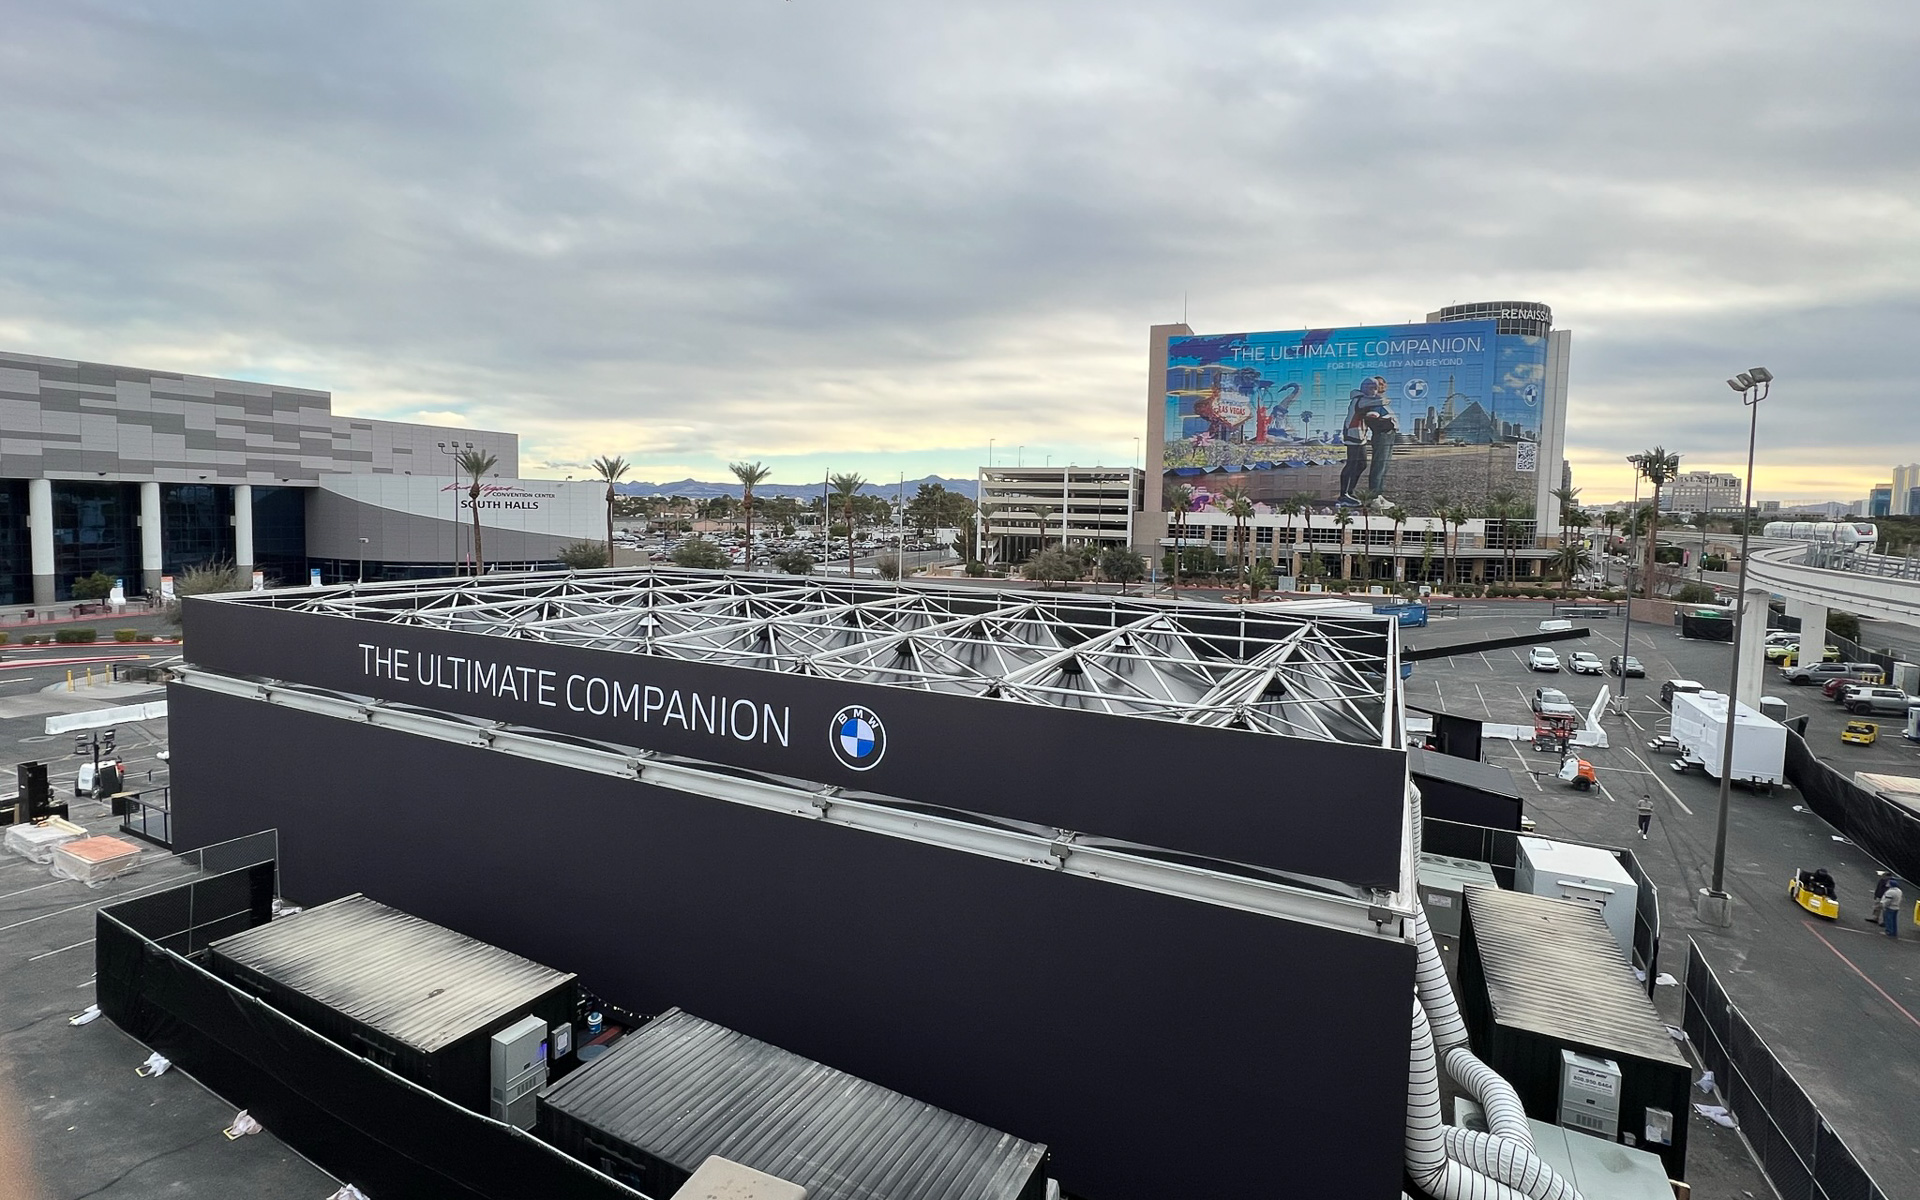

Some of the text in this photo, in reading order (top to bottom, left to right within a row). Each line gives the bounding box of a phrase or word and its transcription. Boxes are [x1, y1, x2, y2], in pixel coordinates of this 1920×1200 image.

[1231, 337, 1485, 361] THE ULTIMATE COMPANION.
[1327, 362, 1345, 370] FOR
[1346, 361, 1365, 369] THIS
[1367, 360, 1402, 369] REALITY
[1404, 359, 1424, 367] AND
[504, 501, 539, 510] HALLS
[358, 643, 790, 747] THE ULTIMATE COMPANION
[837, 708, 879, 729] BMW
